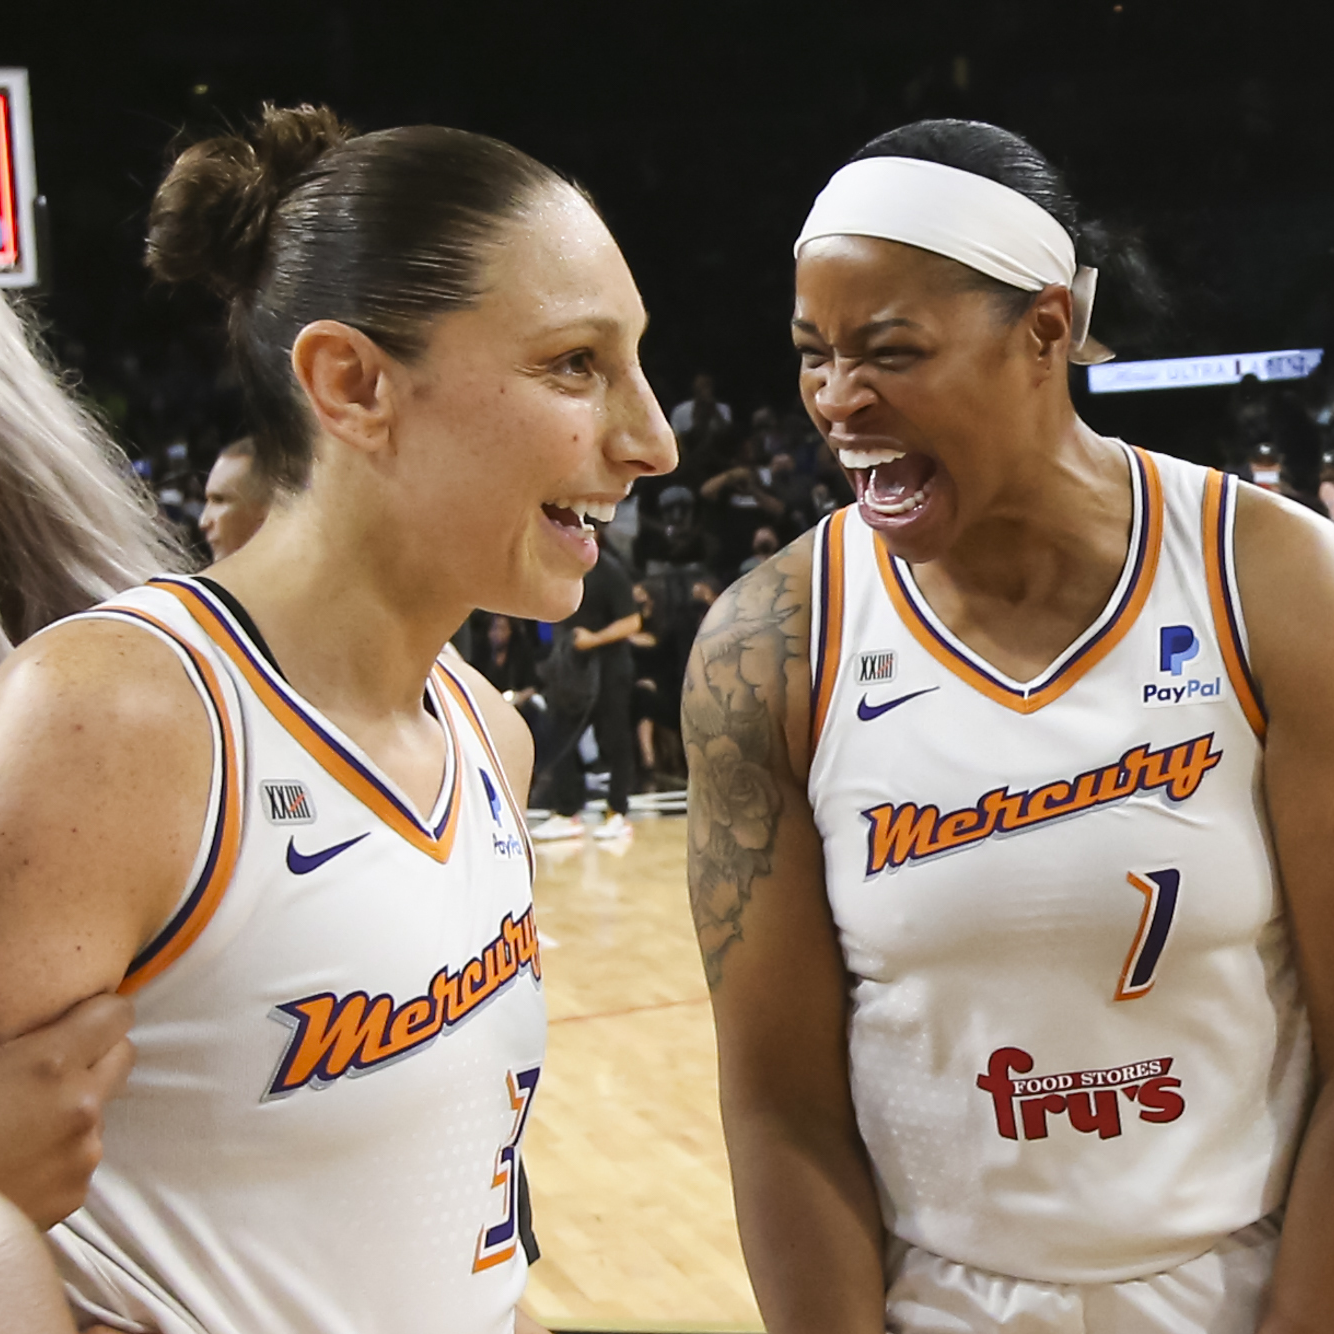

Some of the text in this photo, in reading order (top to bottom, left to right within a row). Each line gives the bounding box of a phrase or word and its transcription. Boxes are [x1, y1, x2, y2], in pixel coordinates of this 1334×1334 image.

[1143, 677, 1221, 703] PayPal
[861, 732, 1223, 877] Mercury
[1113, 868, 1181, 1001] 1
[264, 903, 541, 1100] Mercury
[976, 1046, 1186, 1141] fry's
[1013, 1061, 1162, 1094] FOOD STORES
